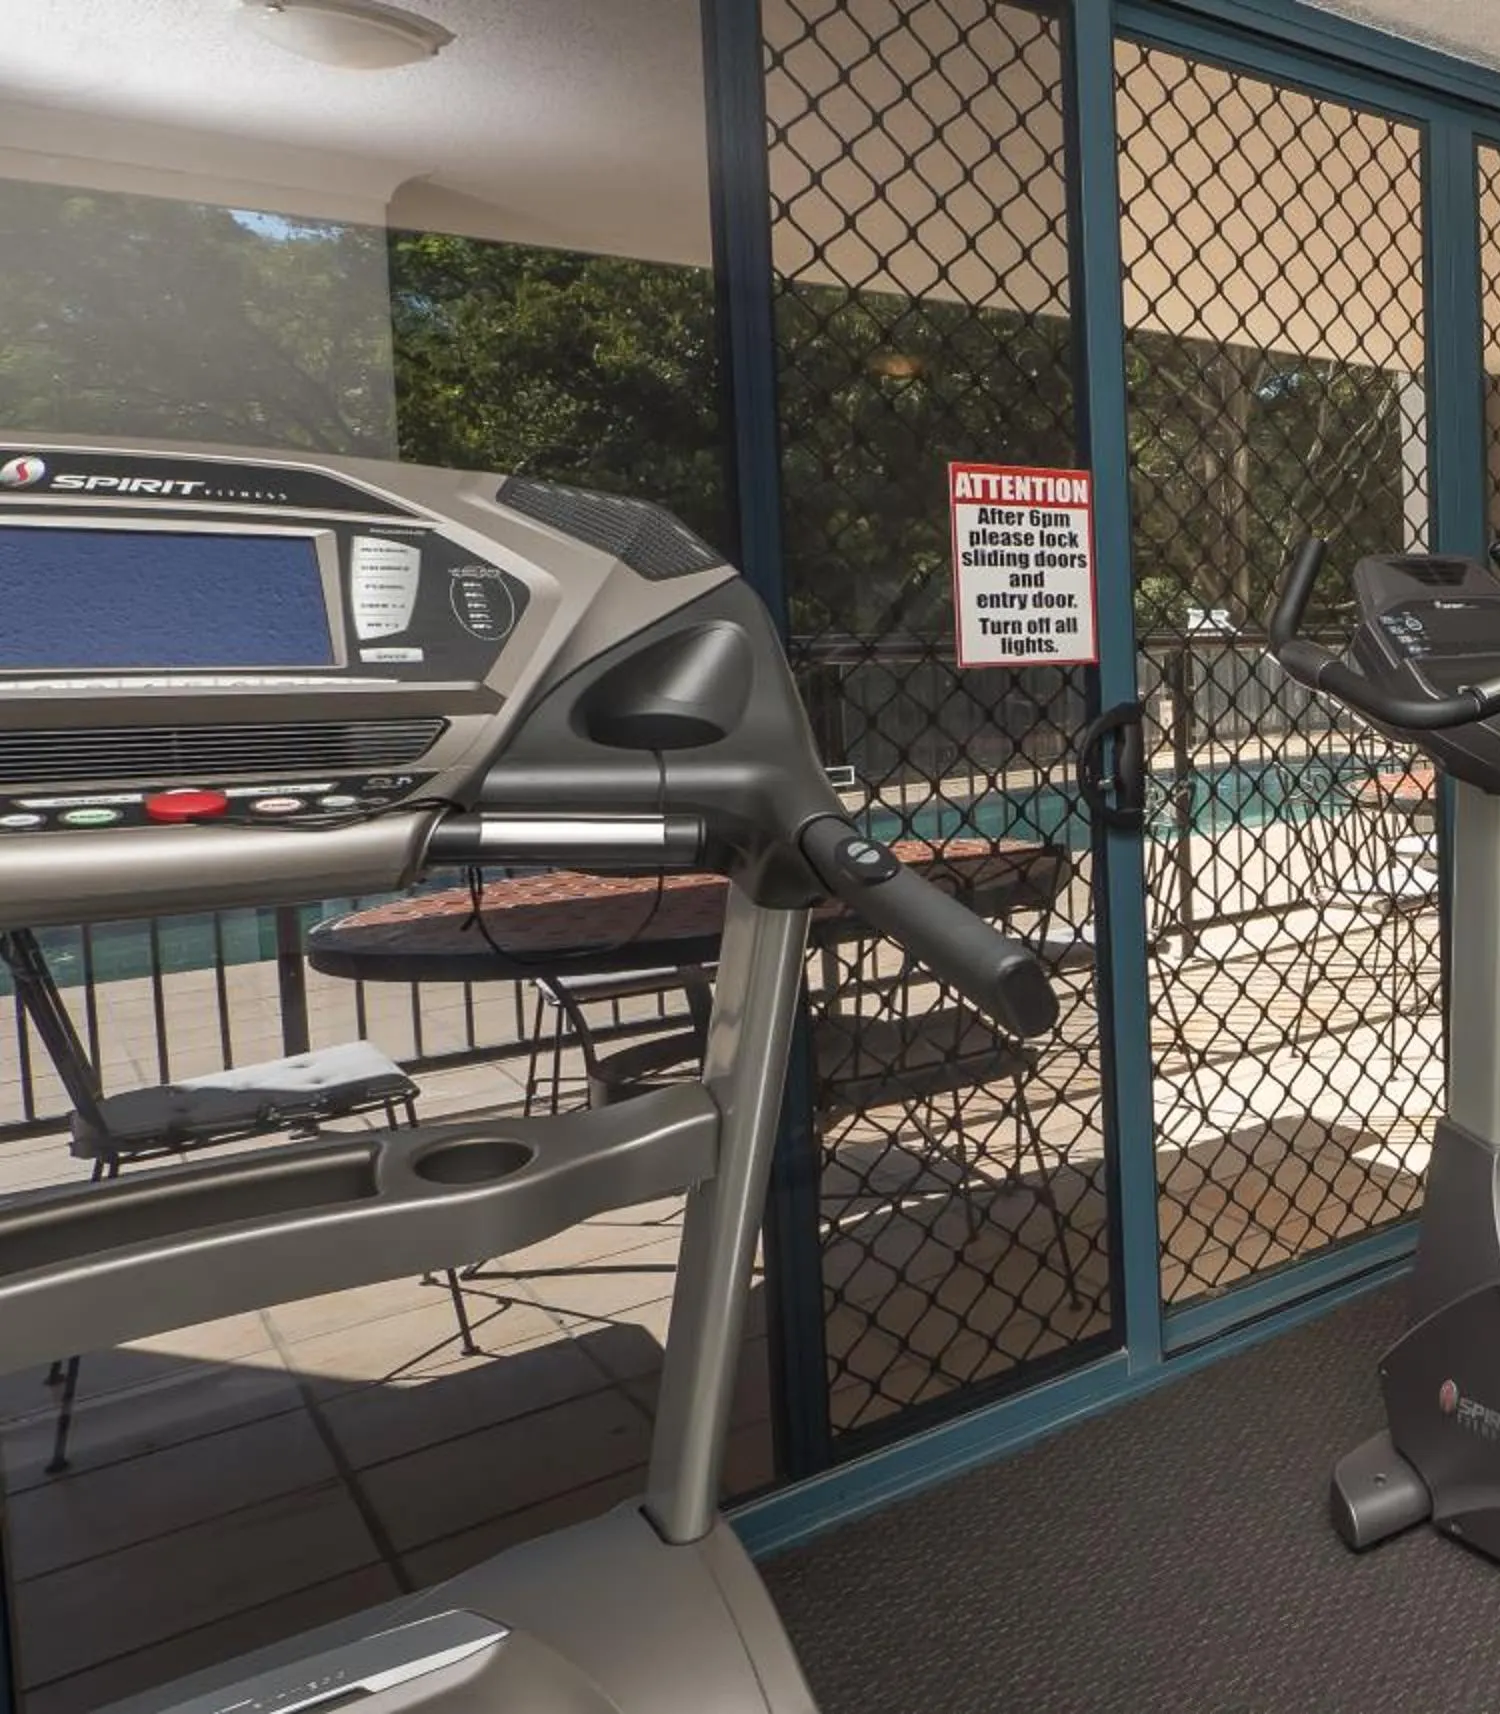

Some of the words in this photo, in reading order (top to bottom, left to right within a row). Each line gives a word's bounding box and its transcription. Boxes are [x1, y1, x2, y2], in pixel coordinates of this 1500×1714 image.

[50, 475, 205, 495] SPIRIT
[955, 472, 1088, 504] ATTENTION
[977, 508, 1024, 526] After
[1029, 510, 1071, 528] 6pm
[969, 529, 1034, 547] please
[1039, 531, 1079, 548] lock
[961, 550, 1030, 569] sliding
[1034, 553, 1088, 569] doors
[1009, 572, 1045, 588] and
[976, 593, 1028, 610] entry
[1032, 592, 1078, 609] door.
[978, 618, 1023, 635] Turn
[1027, 618, 1051, 635] off
[1055, 618, 1078, 634] all
[1001, 637, 1059, 656] lights.
